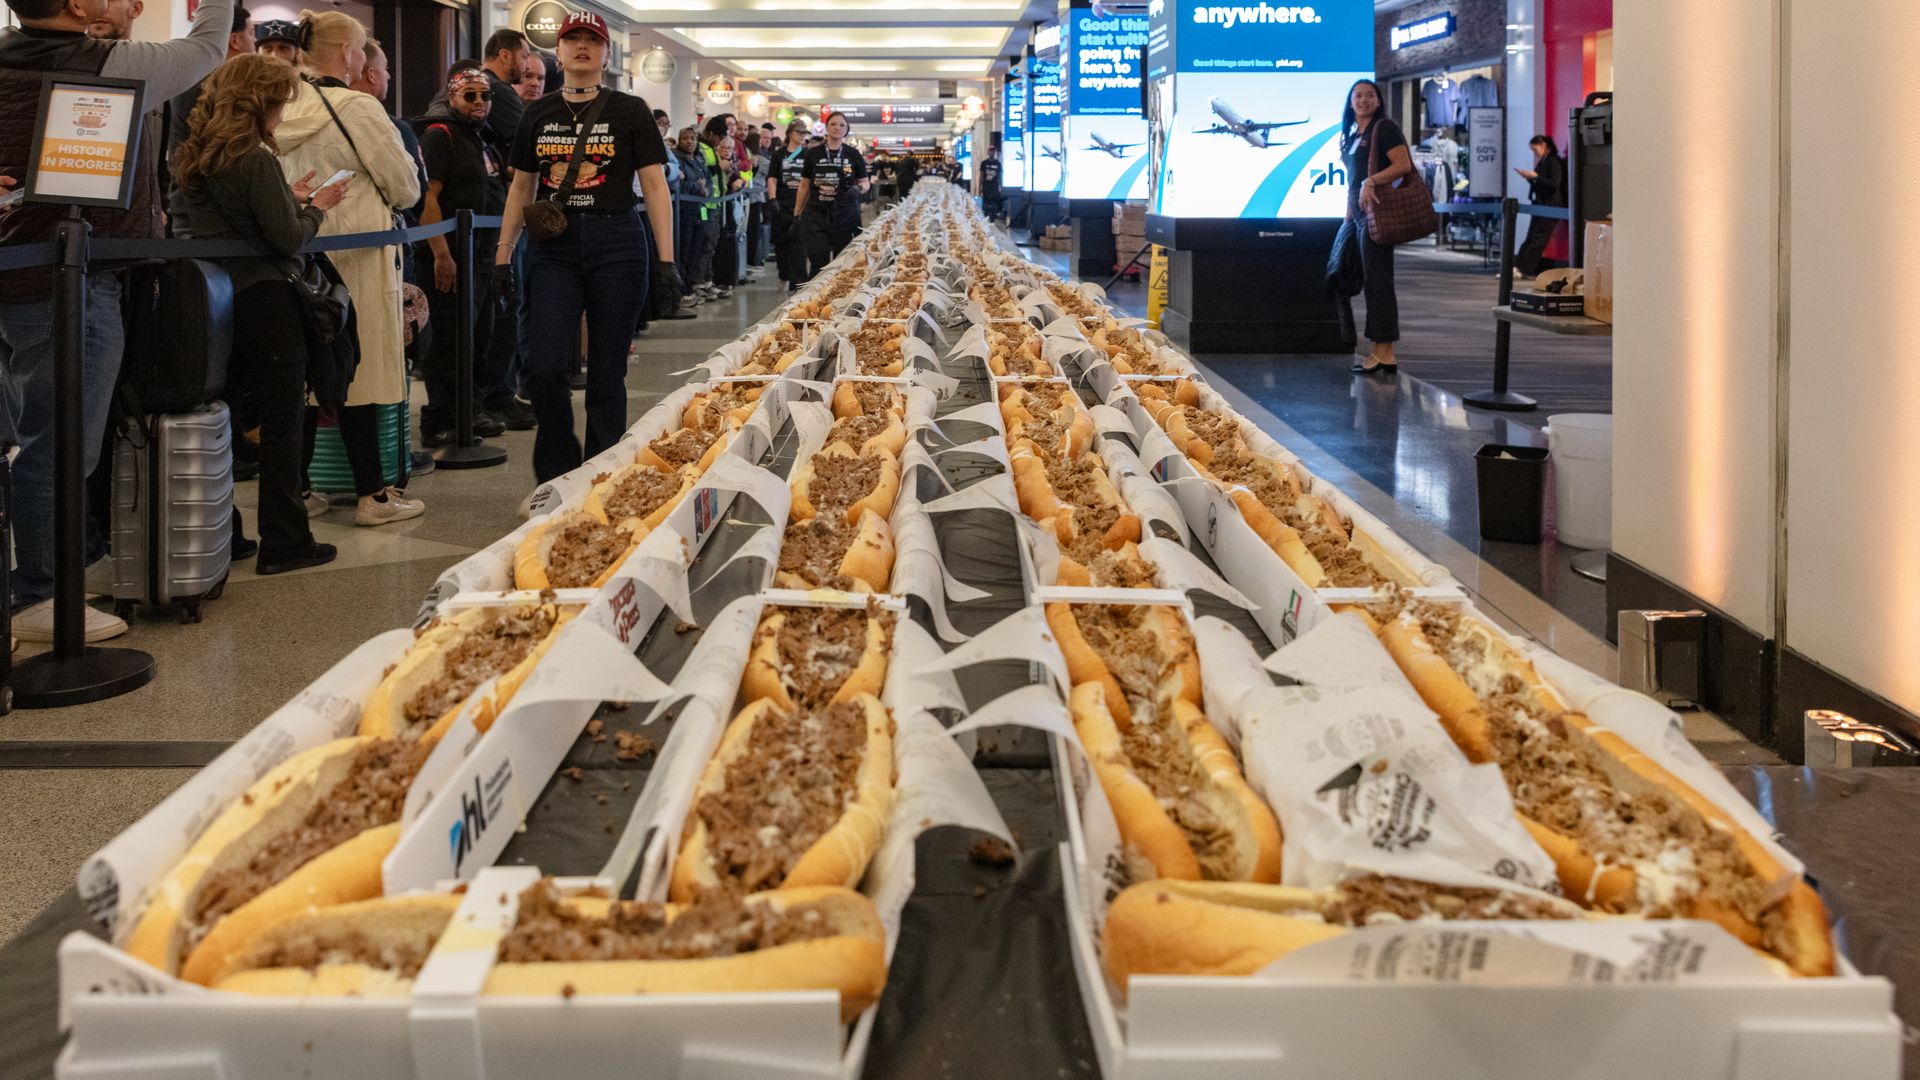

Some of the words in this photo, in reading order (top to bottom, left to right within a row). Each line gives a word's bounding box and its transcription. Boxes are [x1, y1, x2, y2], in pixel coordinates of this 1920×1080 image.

[569, 12, 600, 27] PHL
[1193, 2, 1321, 28] anywhere.
[1079, 18, 1119, 31] Good
[1121, 18, 1149, 31] thin
[1079, 33, 1114, 45] start
[1116, 33, 1148, 45] with
[1079, 46, 1121, 62] going
[1079, 62, 1112, 74] here
[1113, 62, 1131, 74] to
[1193, 59, 1213, 67] Good
[1079, 75, 1142, 91] anywher
[543, 122, 558, 133] phl
[537, 135, 578, 144] LONGEST
[600, 135, 614, 144] OF
[58, 144, 113, 157] HISTORY
[43, 156, 56, 166] IN
[59, 157, 124, 171] PROGRESS
[1477, 154, 1496, 163] OFF
[1310, 163, 1345, 193] ph
